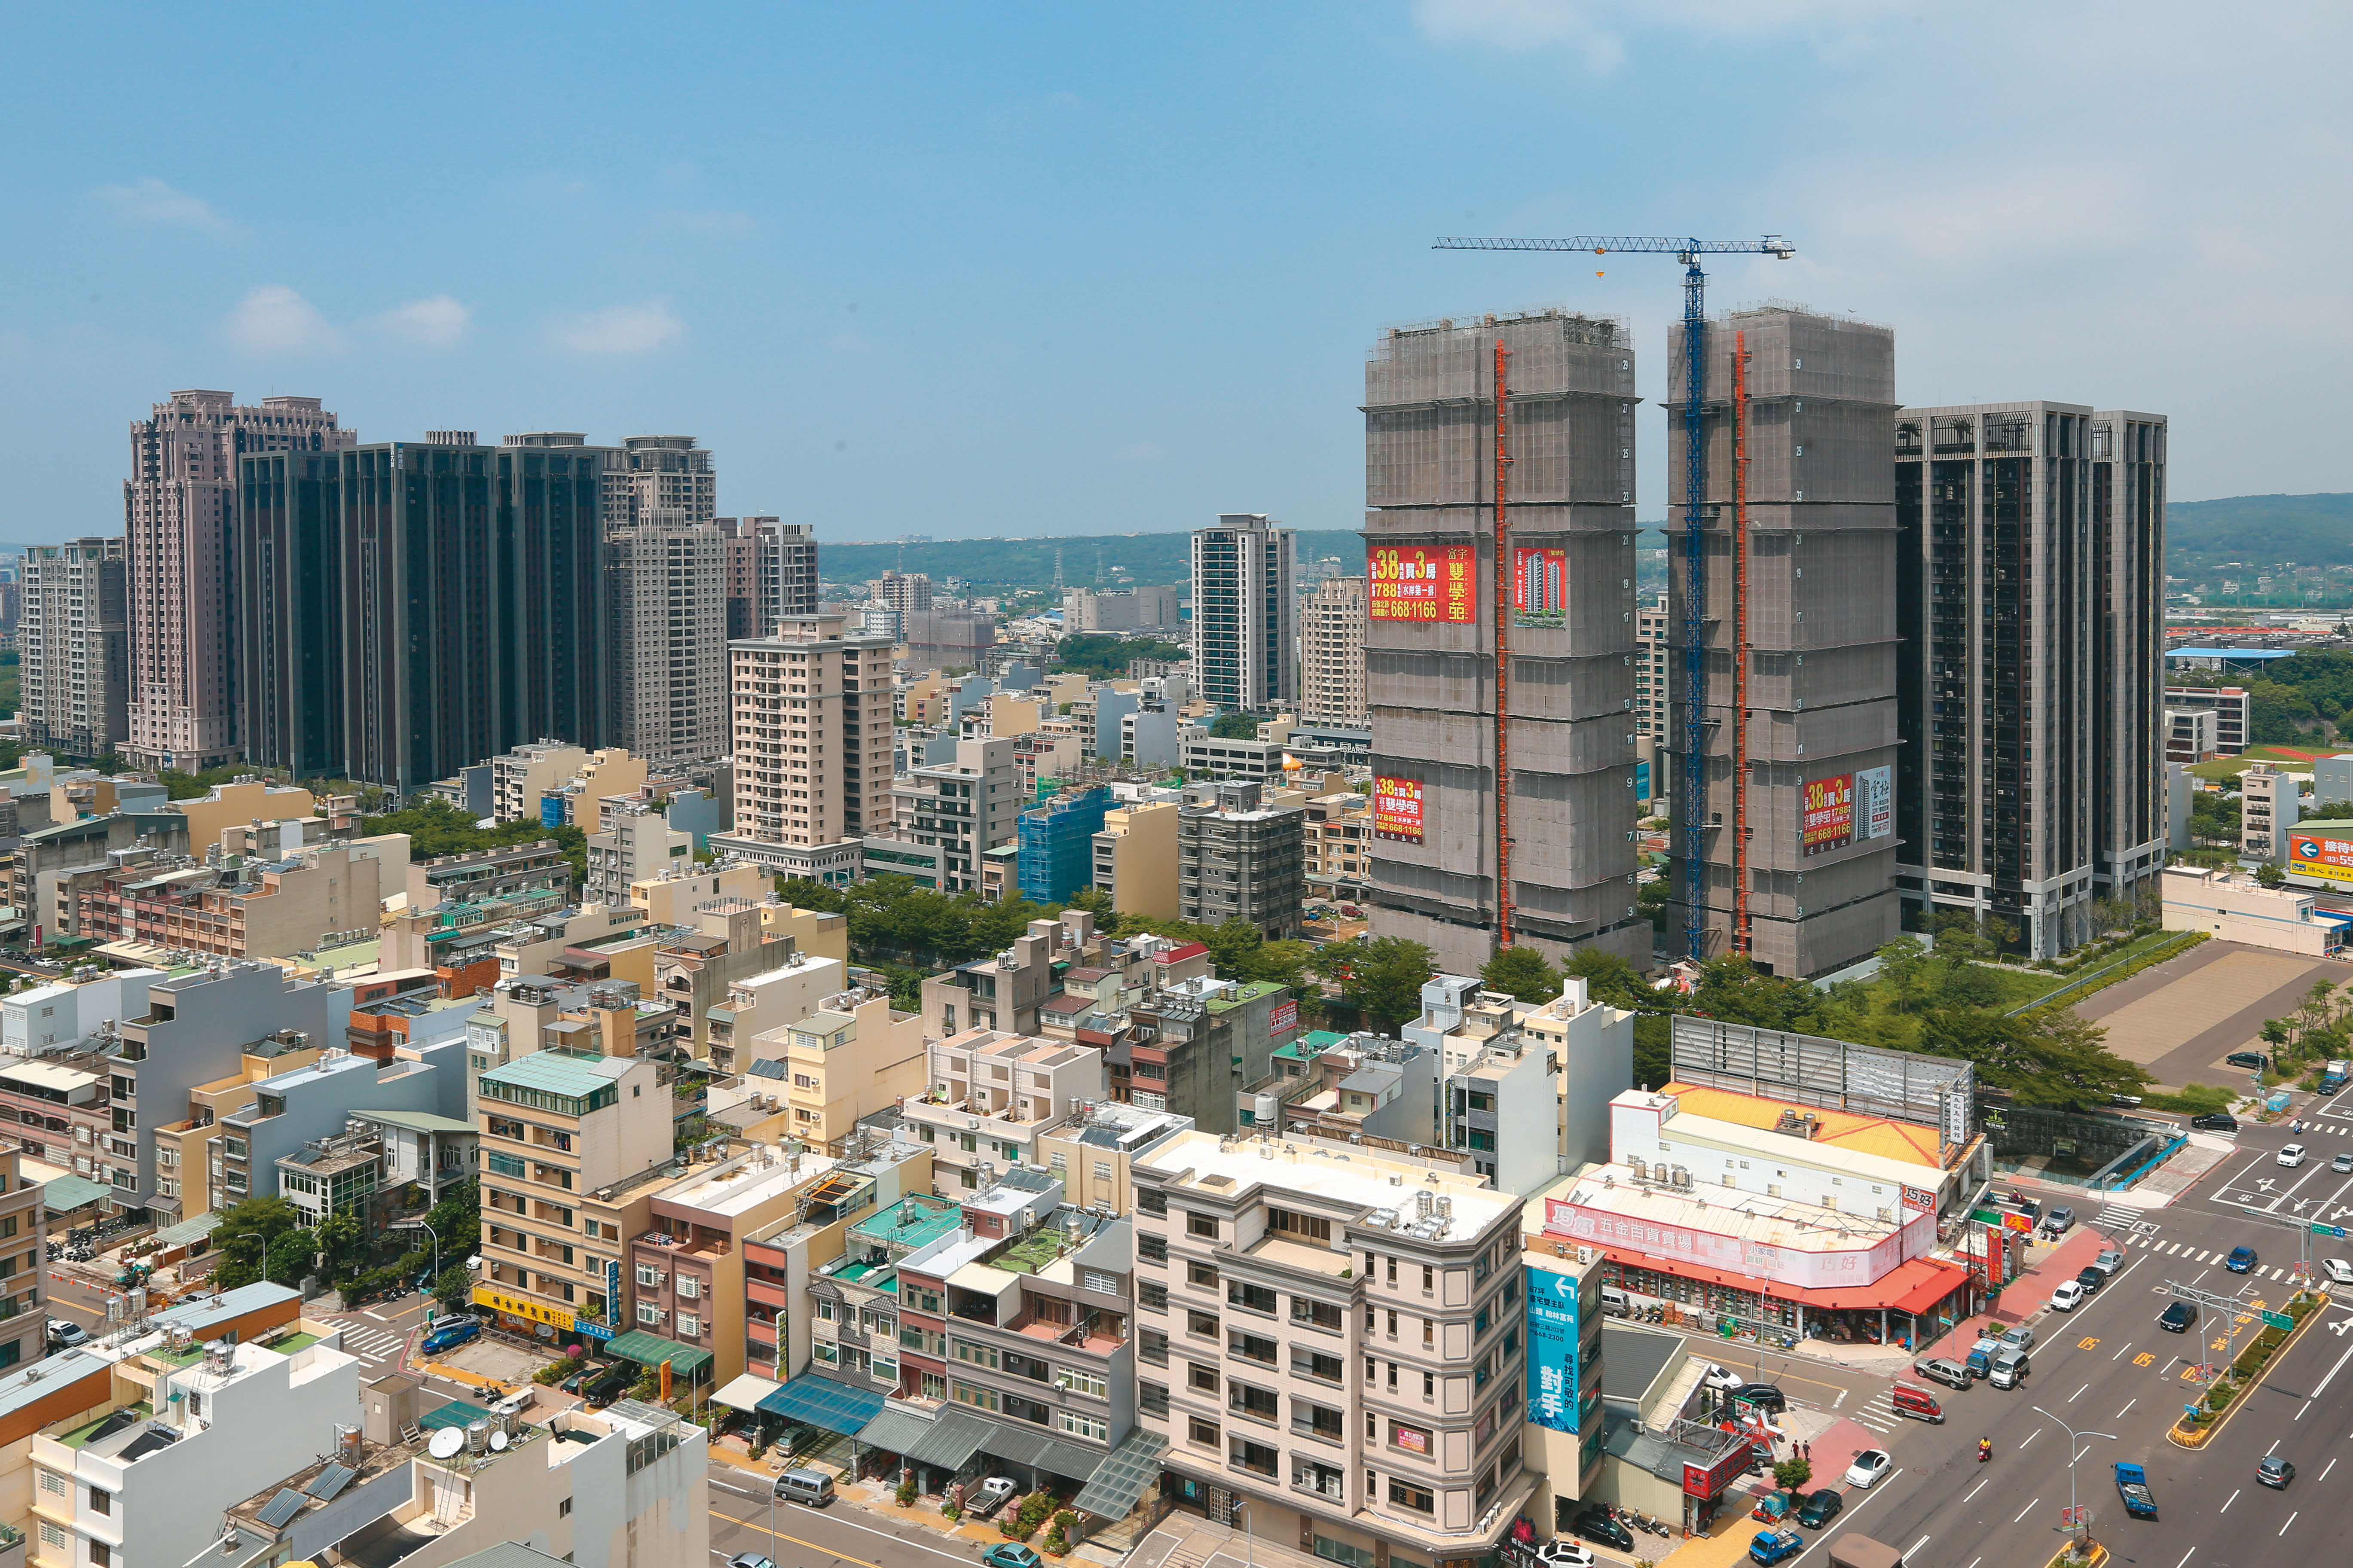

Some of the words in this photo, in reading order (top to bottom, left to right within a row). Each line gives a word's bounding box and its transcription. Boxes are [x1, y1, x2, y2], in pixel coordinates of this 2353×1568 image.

[1623, 359, 1629, 370] 29
[1796, 358, 1801, 369] 29
[1623, 403, 1628, 414] 27
[1796, 402, 1801, 413] 27
[1623, 448, 1629, 459] 25
[1796, 445, 1802, 457] 25
[1623, 491, 1629, 502] 23
[1797, 490, 1802, 501] 23
[1623, 535, 1629, 546] 21
[1796, 534, 1801, 545] 21
[1448, 548, 1467, 560] 富宇
[1796, 568, 1801, 578] 19
[1623, 579, 1629, 589] 19
[1403, 585, 1434, 596] 水岸第一排
[1449, 562, 1465, 620] 雙學苑
[1391, 601, 1436, 618] 668-1166
[1624, 612, 1629, 622] 17
[1797, 611, 1802, 622] 17
[1624, 656, 1629, 666] 15
[1797, 656, 1802, 666] 15
[1624, 699, 1629, 709] 13
[1797, 699, 1801, 708] 13
[1627, 734, 1633, 744] 11
[1627, 777, 1632, 787] 9
[1797, 775, 1802, 786] 9
[1386, 797, 1418, 814] 雙學苑
[1809, 810, 1830, 827] 雙學苑
[1389, 823, 1422, 836] 668-1166
[1797, 830, 1803, 840] 7
[1818, 822, 1850, 840] 668-1166
[1380, 832, 1418, 843] 建築基地
[1627, 831, 1633, 842] 7
[2324, 840, 2353, 854] 接待
[1627, 874, 1632, 884] 5
[1797, 873, 1802, 883] 5
[1628, 906, 1633, 916] 3
[1797, 906, 1802, 916] 3
[1905, 1187, 1932, 1206] 巧好
[1552, 1205, 1595, 1236] 巧好
[2006, 1215, 2030, 1231] 床
[1600, 1217, 1692, 1250] 五金百貨賣場
[1749, 1245, 1775, 1257] 小家電
[1529, 1286, 1545, 1295] 67坪
[1529, 1294, 1565, 1309] 豪宅雙主臥
[506, 1315, 526, 1326] CAFE
[576, 1322, 612, 1338] 立心中醫診所
[1534, 1330, 1564, 1342] 668-2300
[2077, 1336, 2100, 1351] 50
[2132, 1352, 2156, 1367] 50
[1564, 1353, 1574, 1410] 尋找可敬的
[1540, 1365, 1564, 1418] 對手
